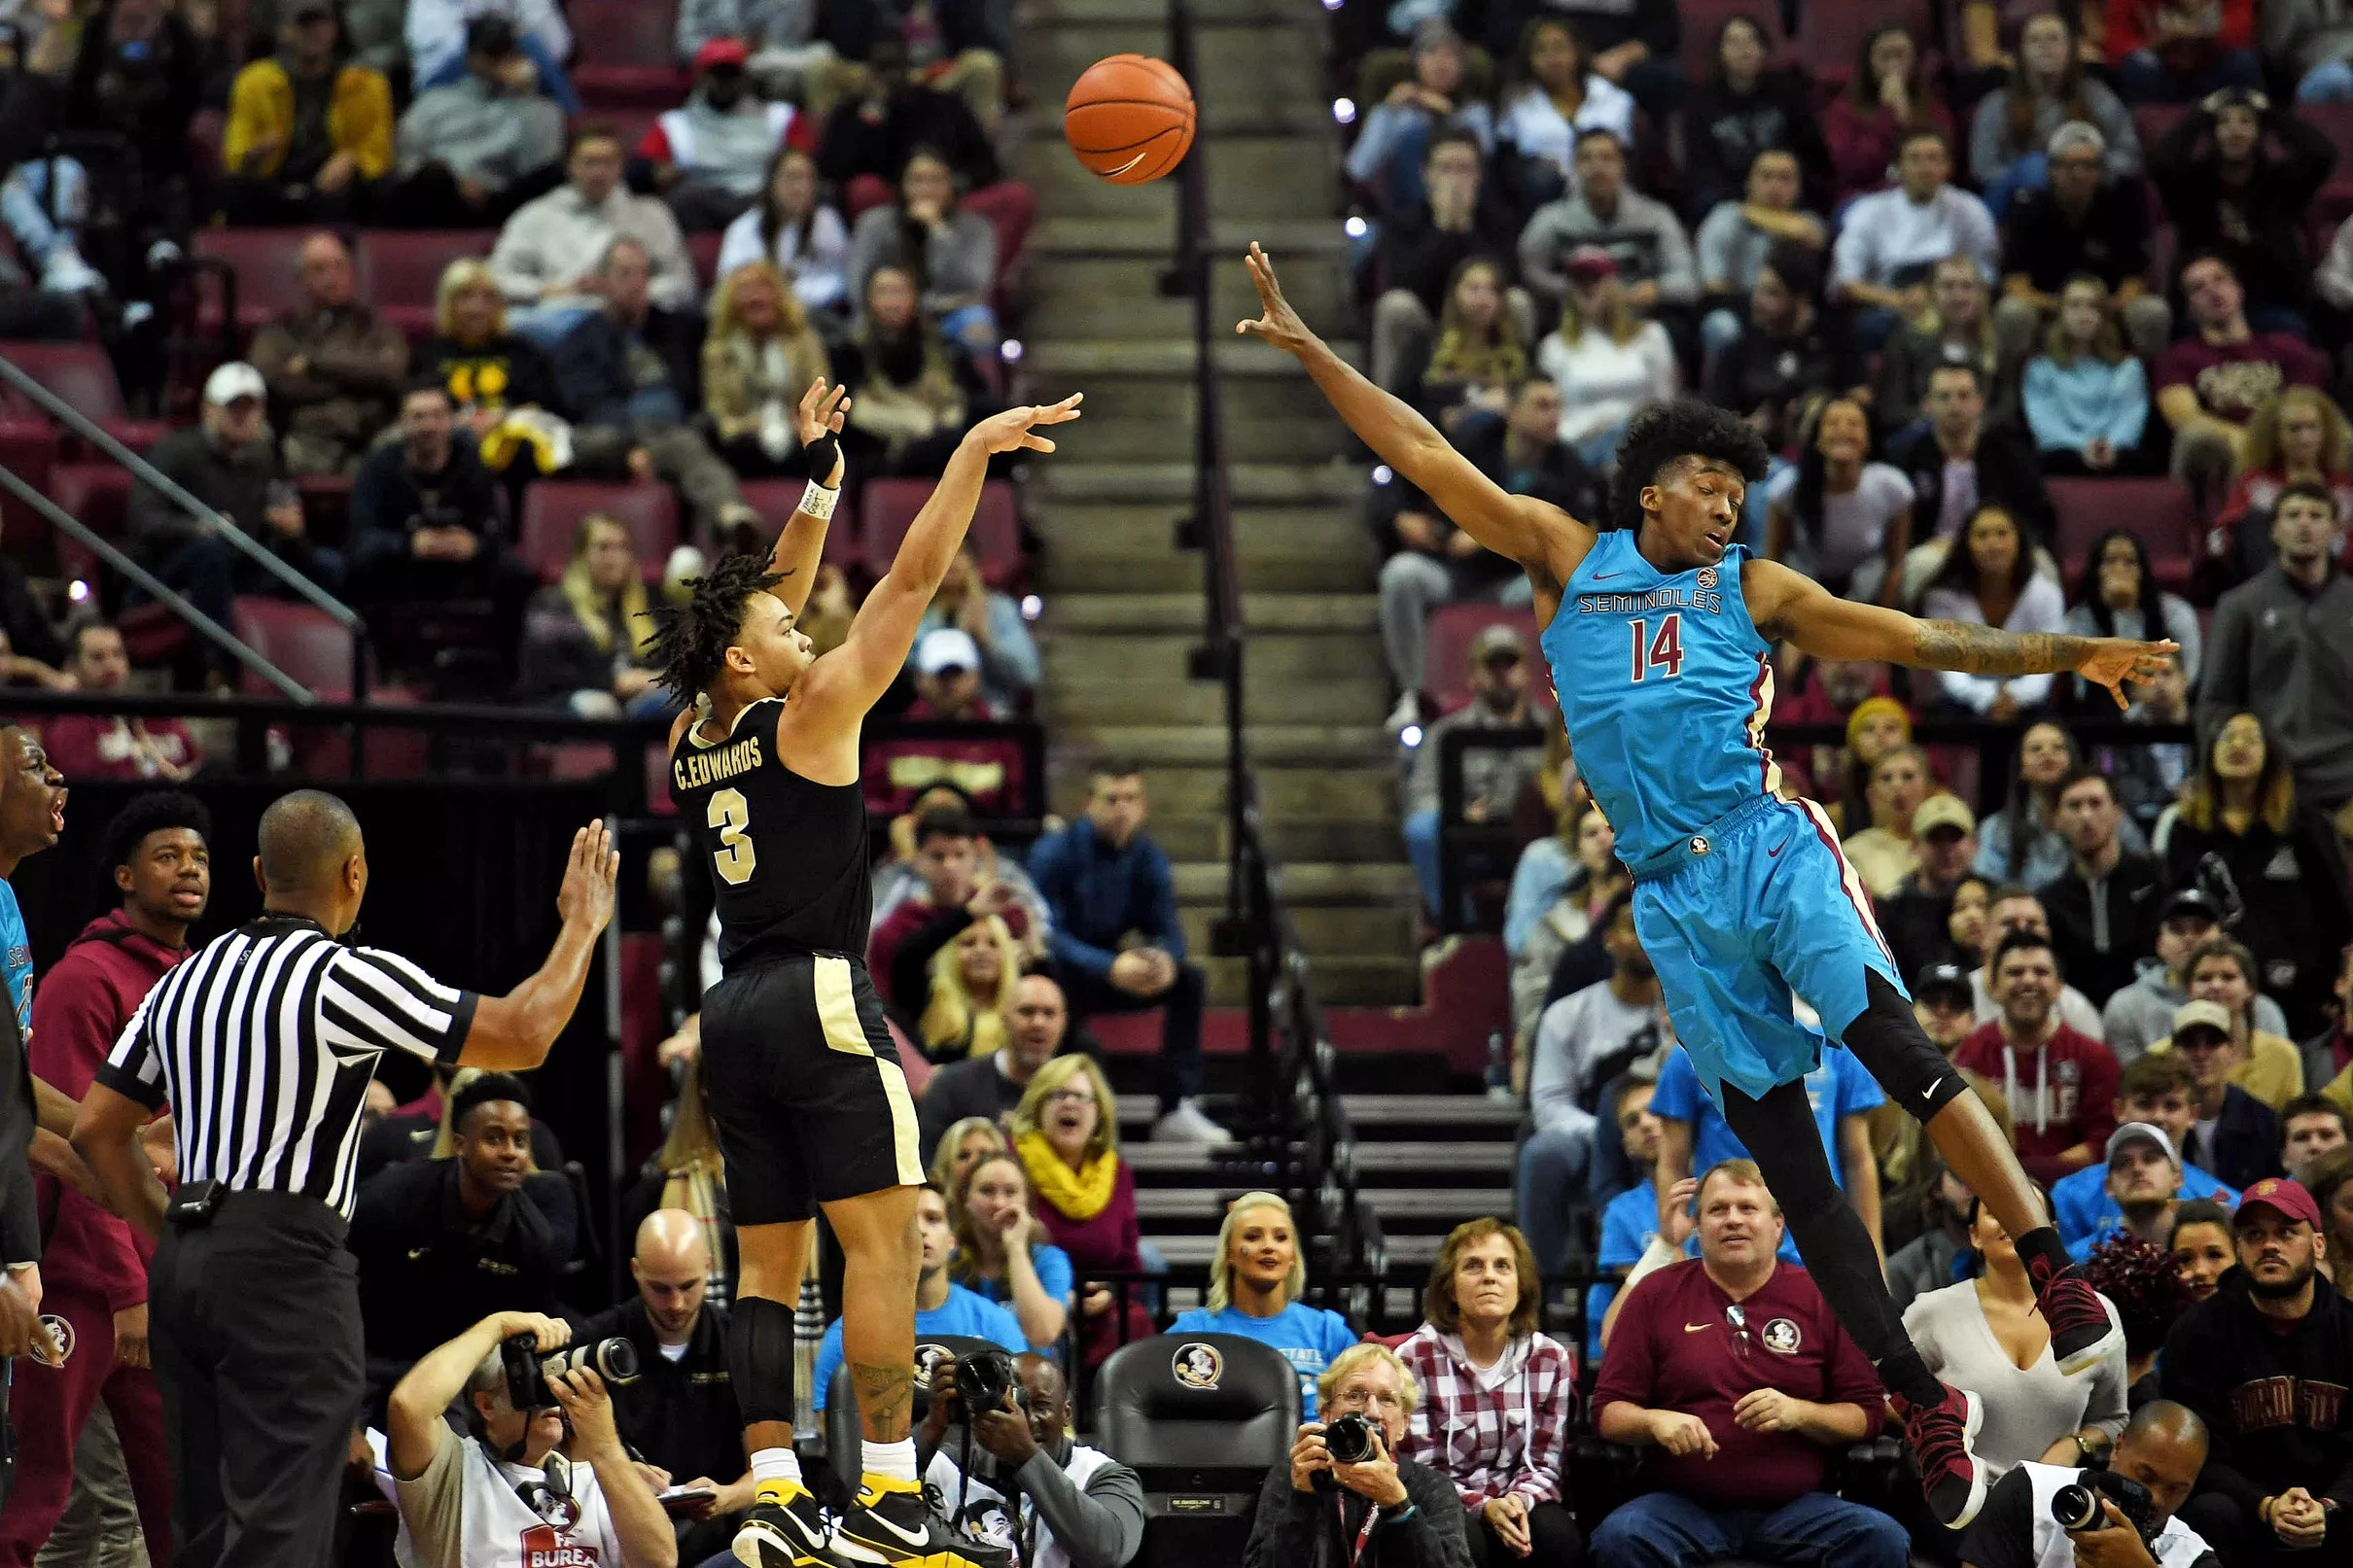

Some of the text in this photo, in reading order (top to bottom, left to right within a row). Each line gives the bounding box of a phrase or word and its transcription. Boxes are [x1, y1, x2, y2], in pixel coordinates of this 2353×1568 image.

[1579, 588, 1722, 615] SEMINOLES
[1627, 612, 1685, 683] 14
[674, 736, 763, 790] C.EDWARDS
[707, 787, 756, 886] 3
